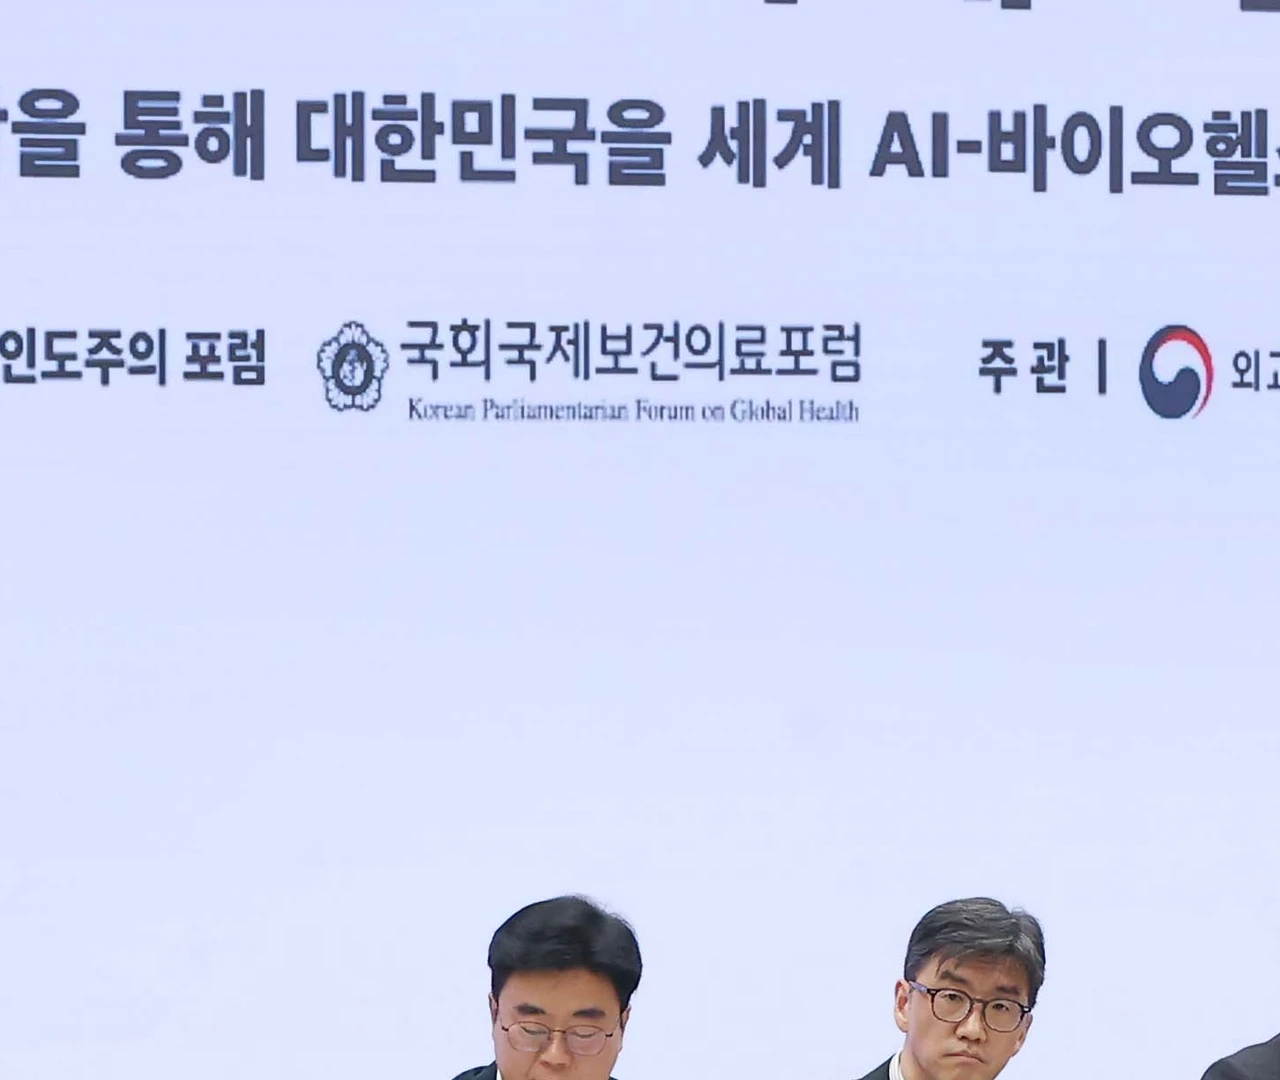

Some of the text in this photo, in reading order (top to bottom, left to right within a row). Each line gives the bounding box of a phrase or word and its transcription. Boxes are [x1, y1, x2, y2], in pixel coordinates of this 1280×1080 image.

[115, 89, 265, 181] 통해
[296, 91, 672, 186] 대한민국을
[697, 98, 841, 189] 세계
[183, 329, 265, 386] 포럼
[400, 318, 861, 383] 국회국제보건의료포럼
[408, 397, 859, 423] Korean Parliamentarian Forum on Global Health
